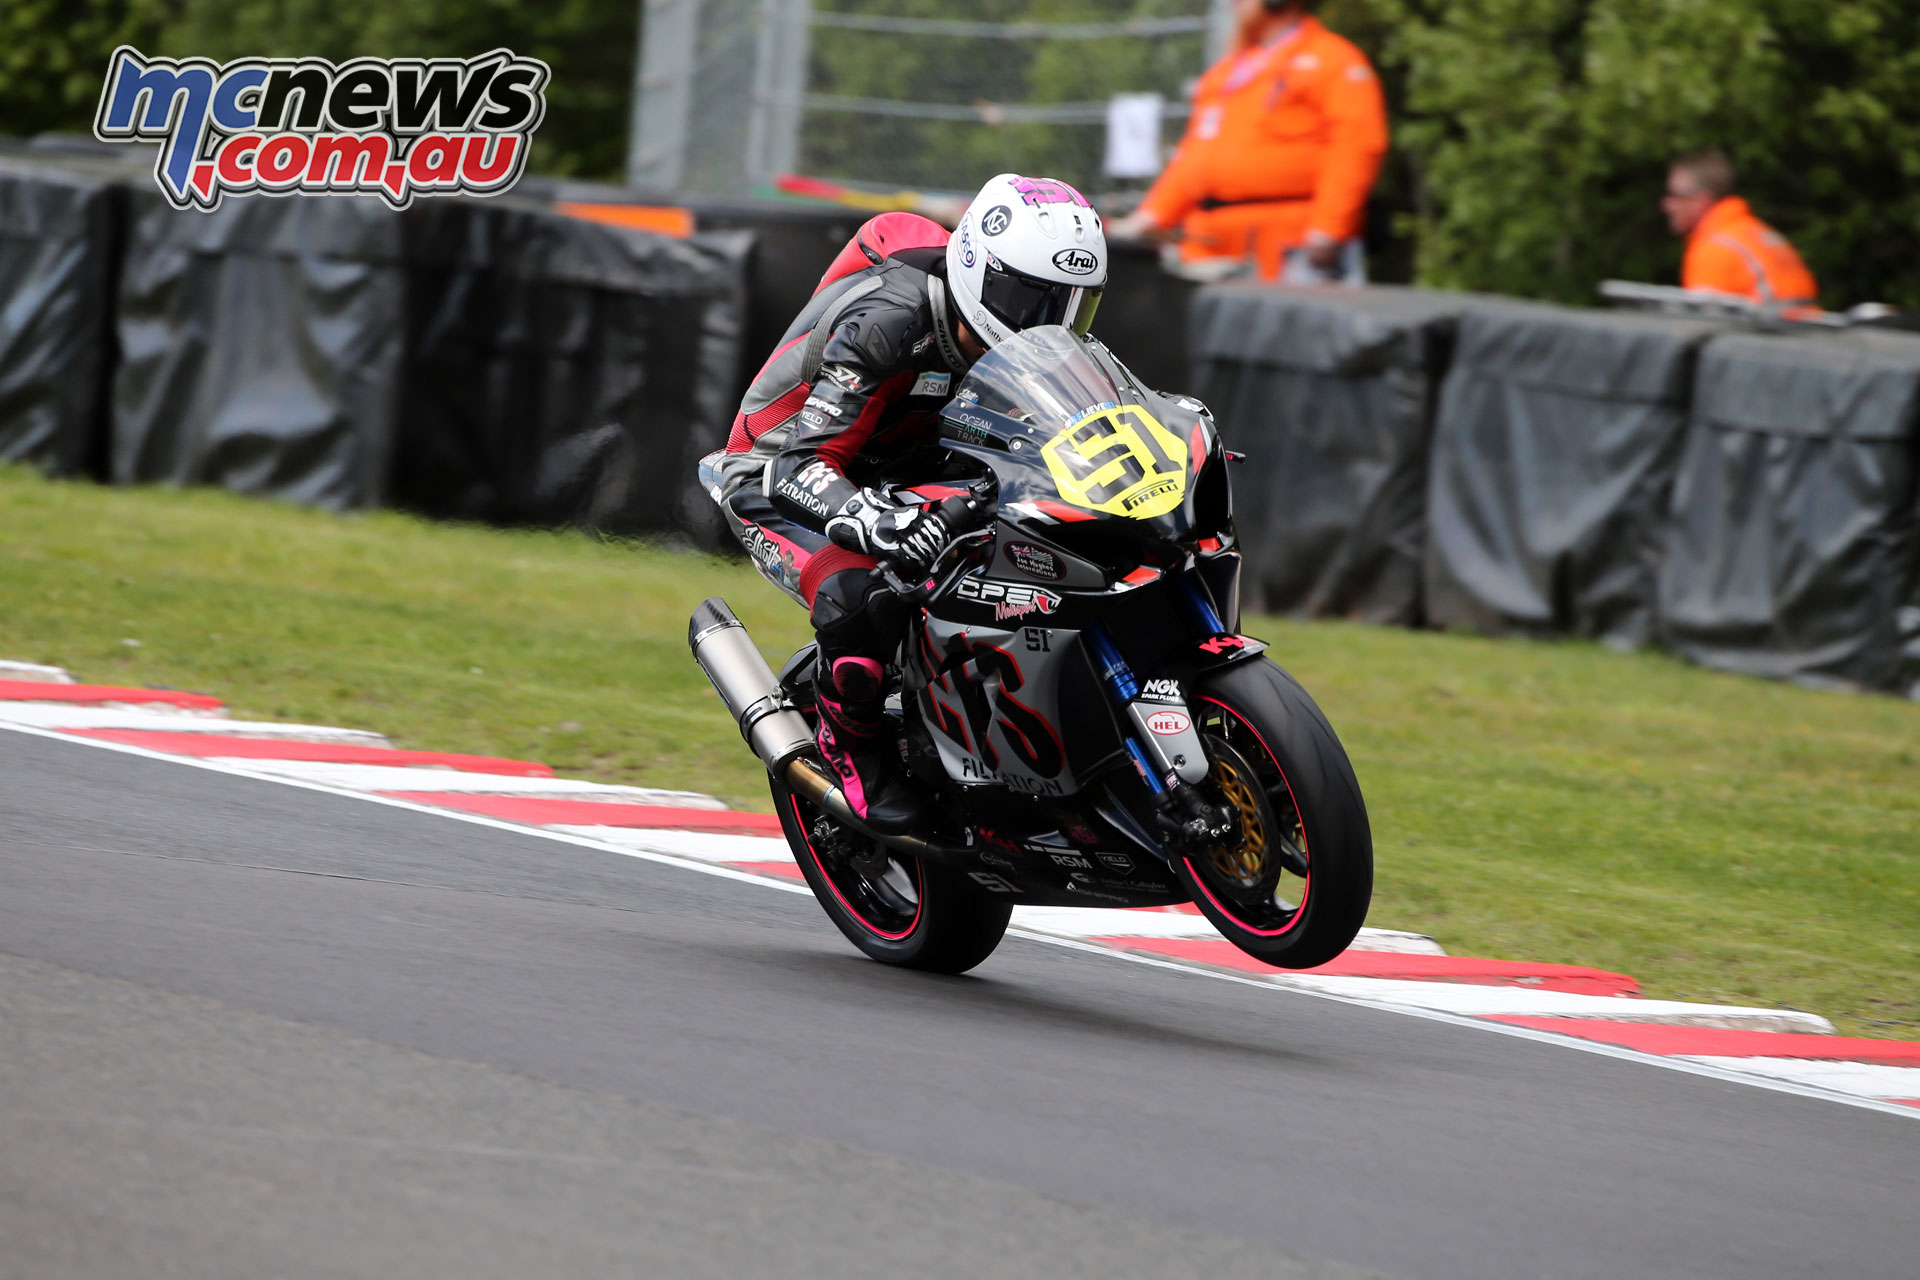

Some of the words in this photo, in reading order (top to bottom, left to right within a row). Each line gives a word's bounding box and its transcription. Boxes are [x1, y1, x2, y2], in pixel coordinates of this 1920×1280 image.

[1055, 250, 1094, 269] Arai
[922, 381, 948, 394] RSM
[801, 410, 823, 425] YIELD
[959, 413, 992, 430] OCEAN
[1054, 411, 1183, 505] 51
[1121, 479, 1178, 512] PIRELLI
[957, 579, 1033, 606] CPE
[1024, 628, 1051, 652] 51
[1143, 679, 1180, 696] NGK
[1154, 721, 1182, 729] HEL
[1050, 854, 1093, 869] RSM
